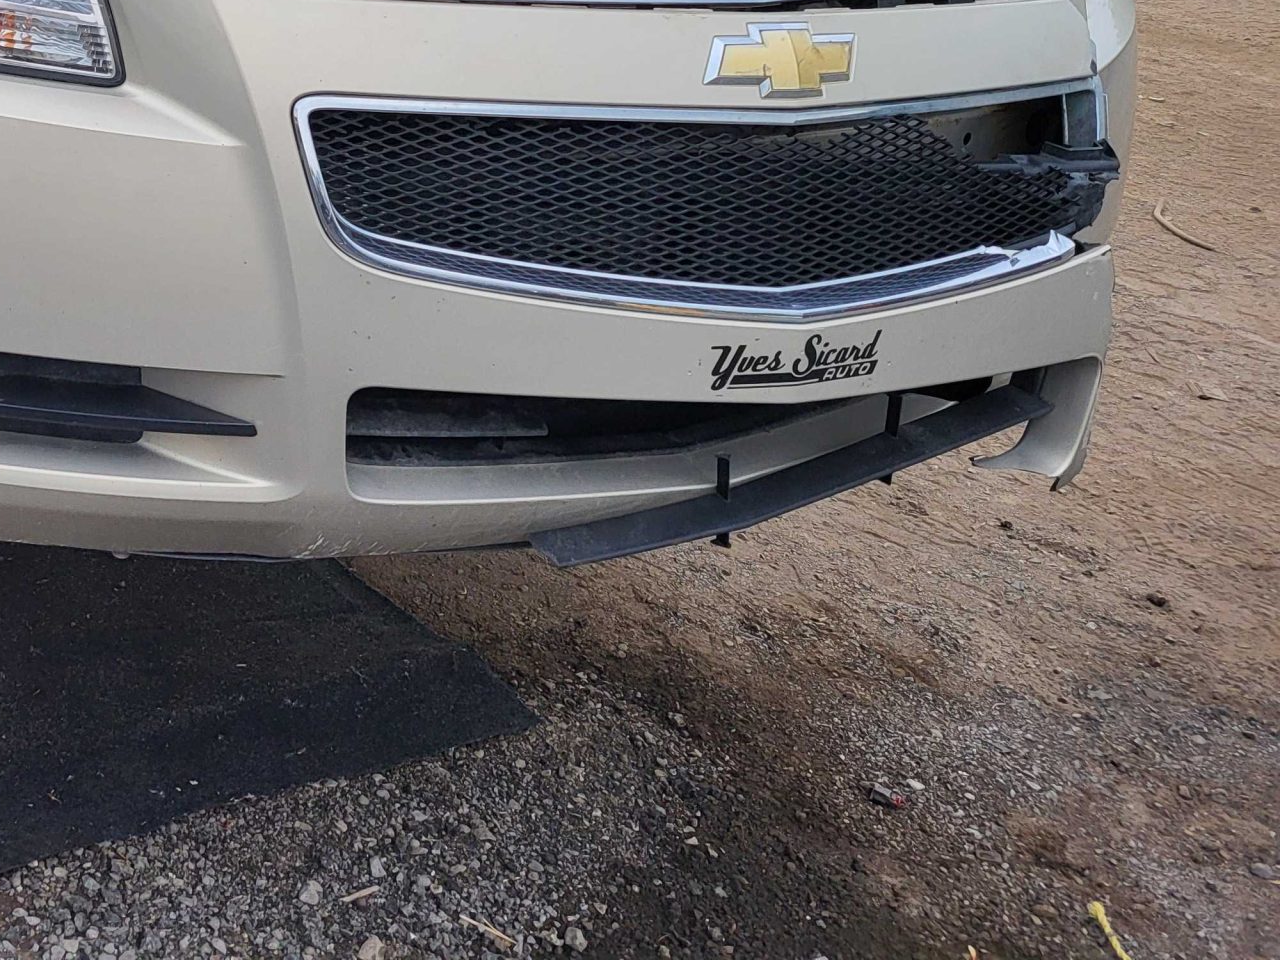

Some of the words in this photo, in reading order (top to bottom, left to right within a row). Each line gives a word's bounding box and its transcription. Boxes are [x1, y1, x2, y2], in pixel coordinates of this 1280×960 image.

[710, 344, 786, 391] Yves
[791, 329, 883, 376] Sicard
[822, 362, 872, 381] AUTO
